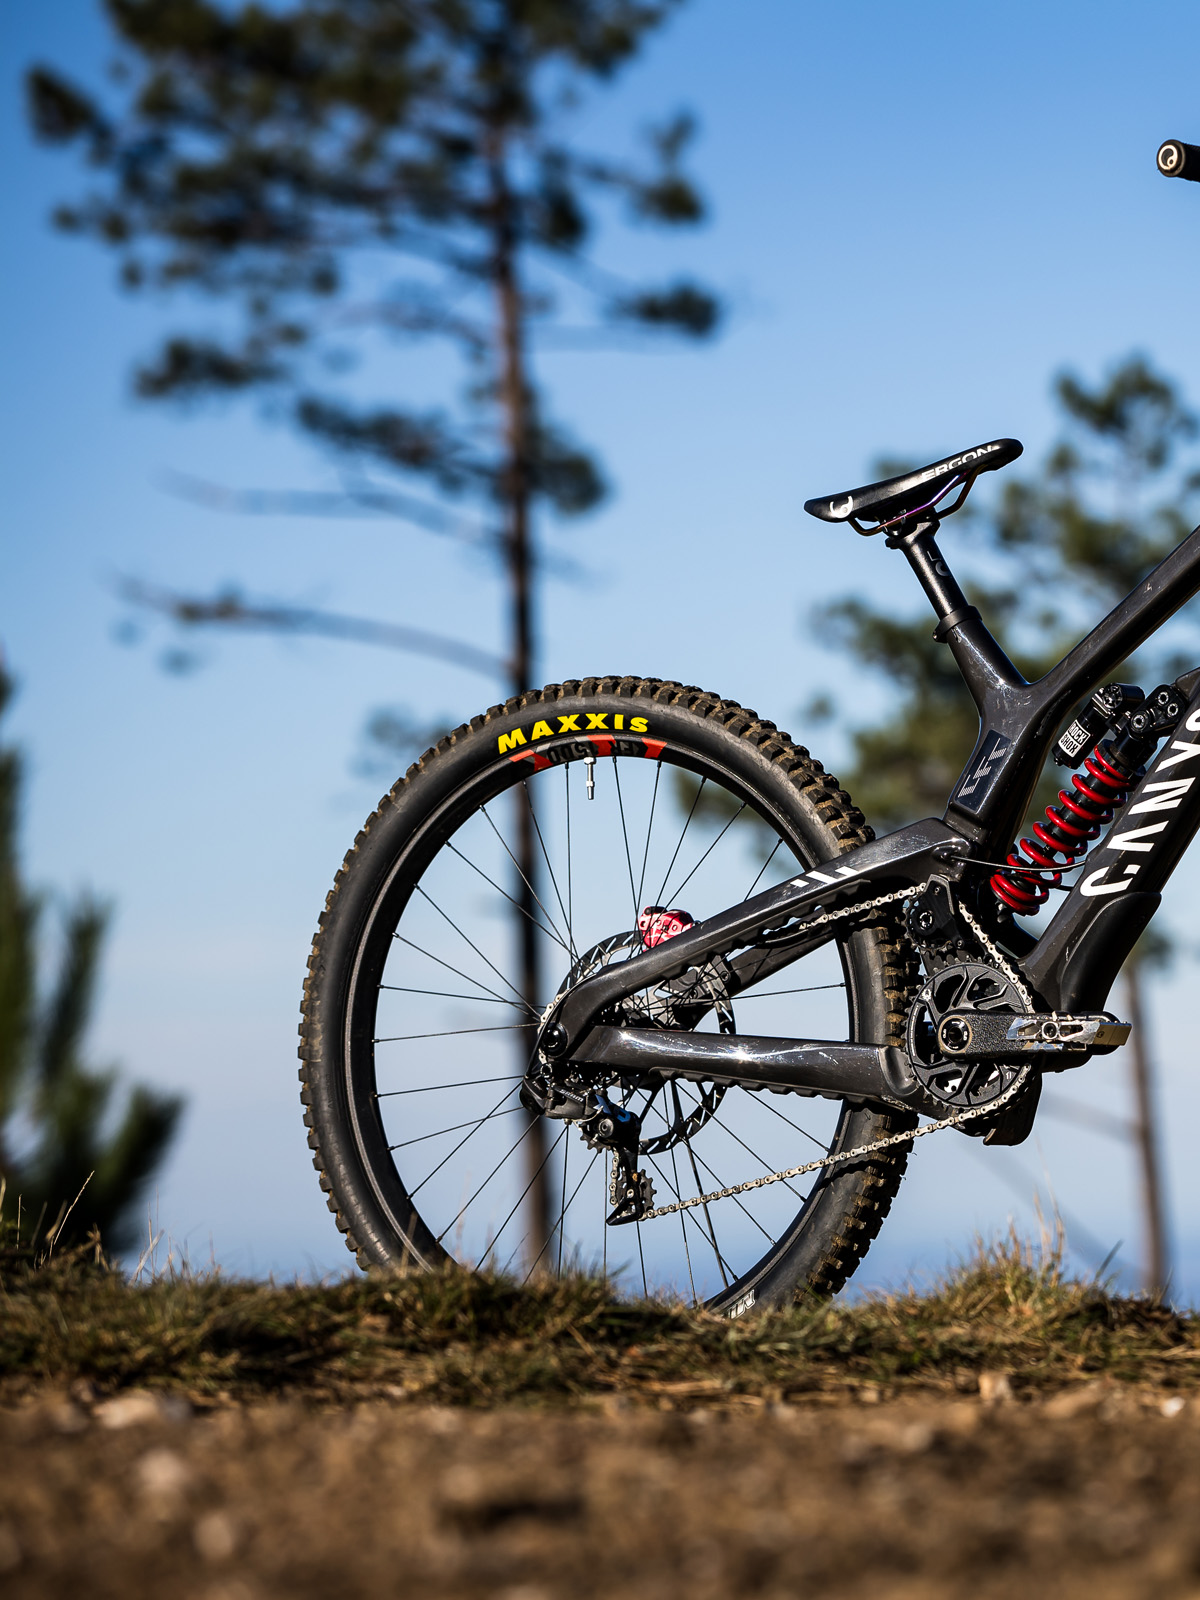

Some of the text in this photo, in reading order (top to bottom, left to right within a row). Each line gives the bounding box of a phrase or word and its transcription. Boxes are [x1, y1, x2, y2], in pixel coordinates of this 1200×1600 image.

[922, 445, 992, 482] ERGON
[497, 713, 649, 755] MAXXIS
[1060, 733, 1079, 754] SHOX
[1068, 721, 1088, 744] ROCK
